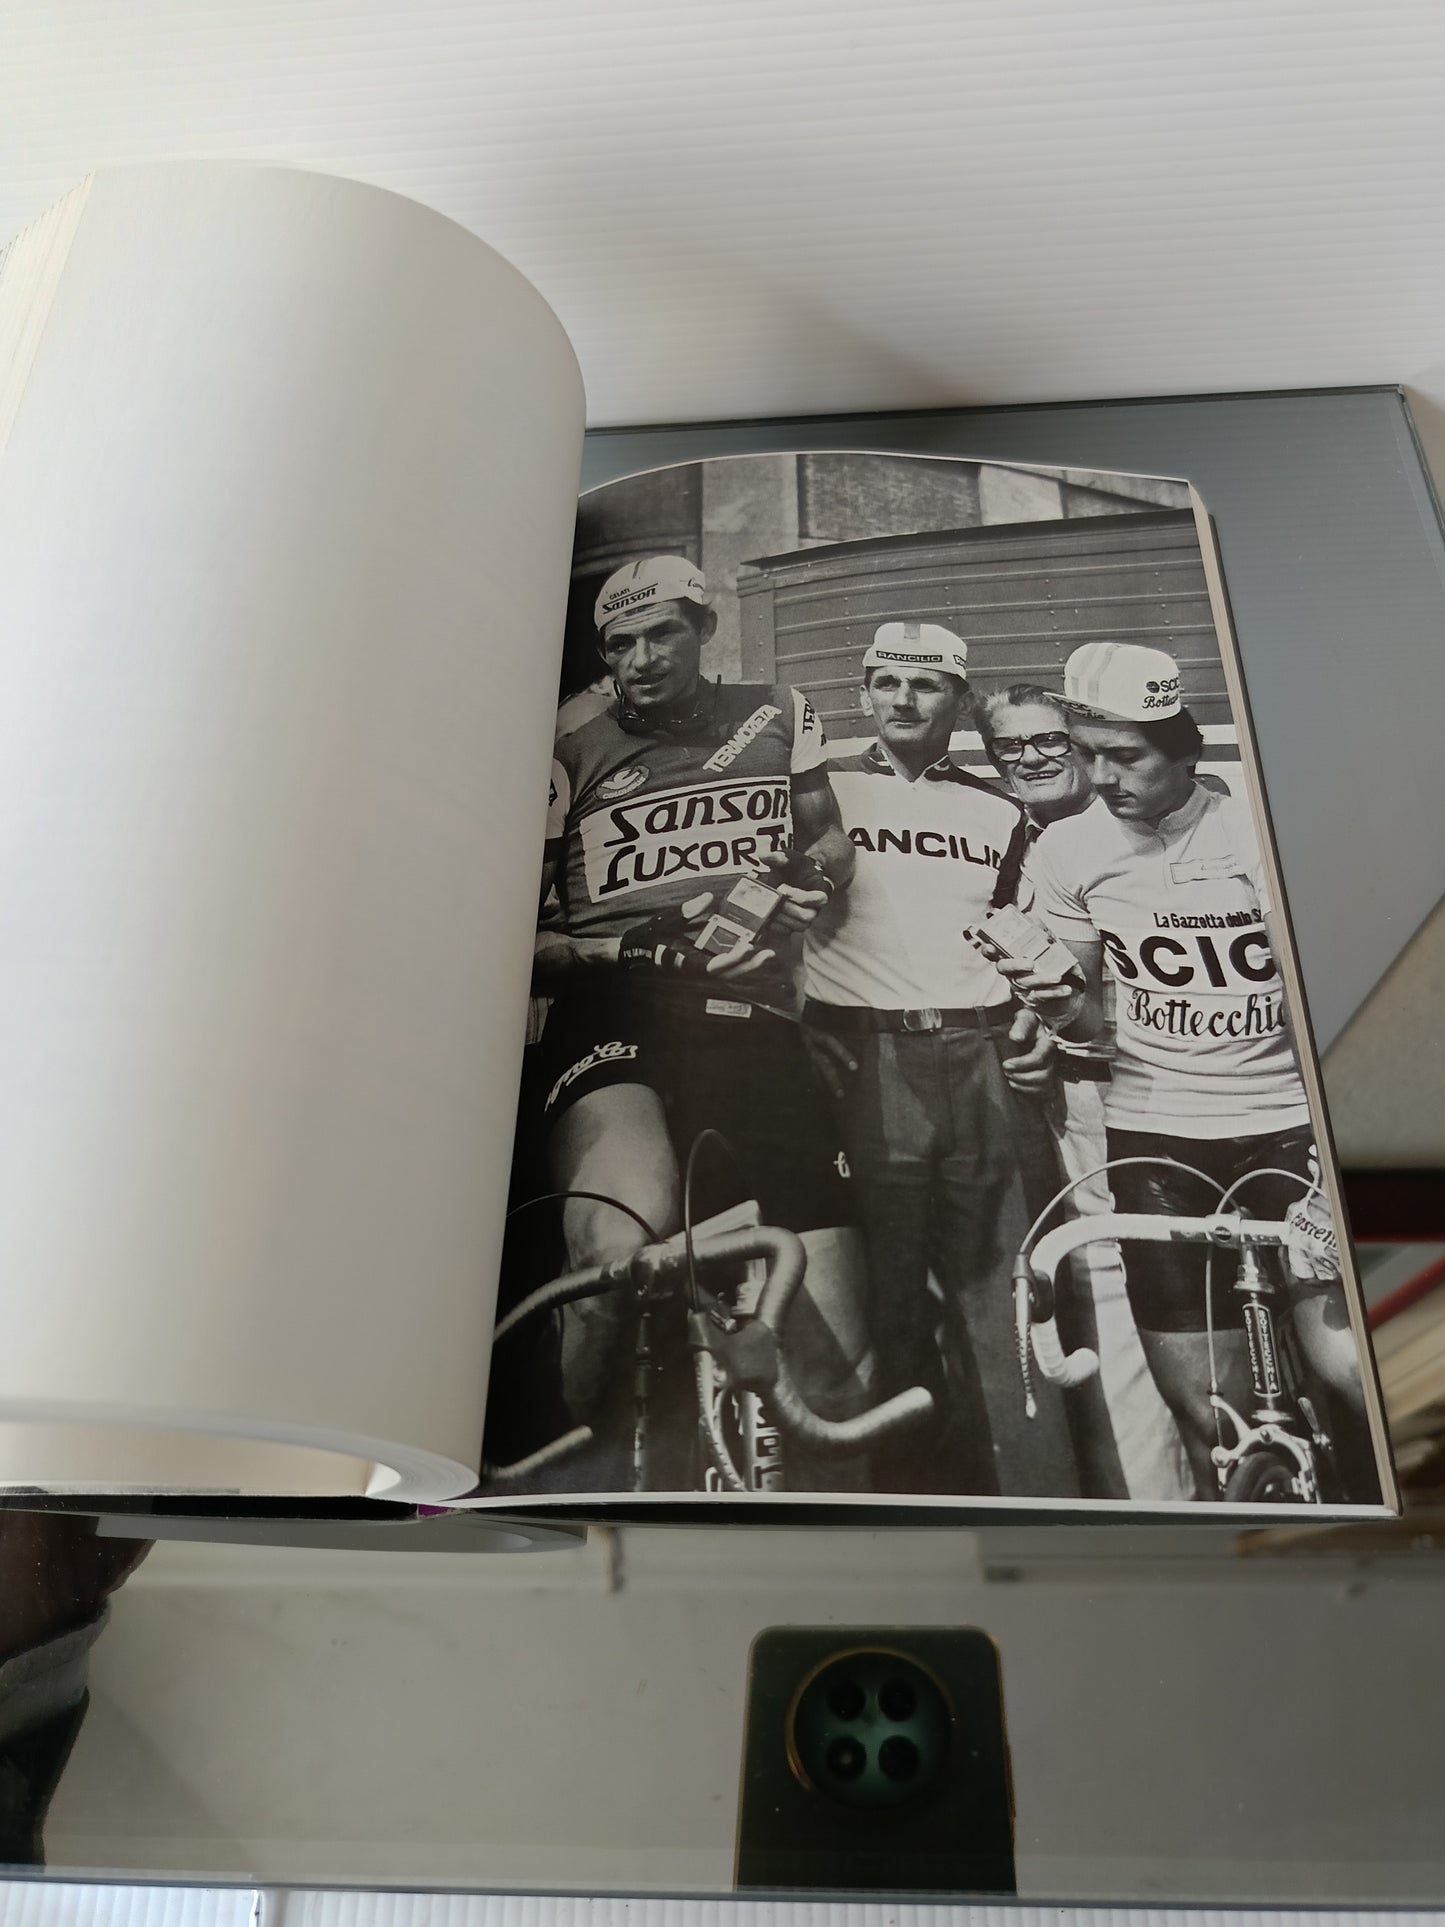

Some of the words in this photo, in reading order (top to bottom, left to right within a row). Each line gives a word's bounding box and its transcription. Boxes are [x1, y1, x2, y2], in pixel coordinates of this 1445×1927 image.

[602, 584, 658, 614] Sanson
[877, 651, 941, 662] RANCILIO
[604, 781, 788, 847] Sanson
[599, 836, 760, 895] LUXOR
[1153, 912, 1170, 928] La
[1170, 912, 1226, 929] Gazzetta
[1100, 929, 1278, 987] SCIC
[1244, 1309, 1261, 1390] BOTTECCHIA
[1258, 1309, 1277, 1390] BOTTECCHIA
